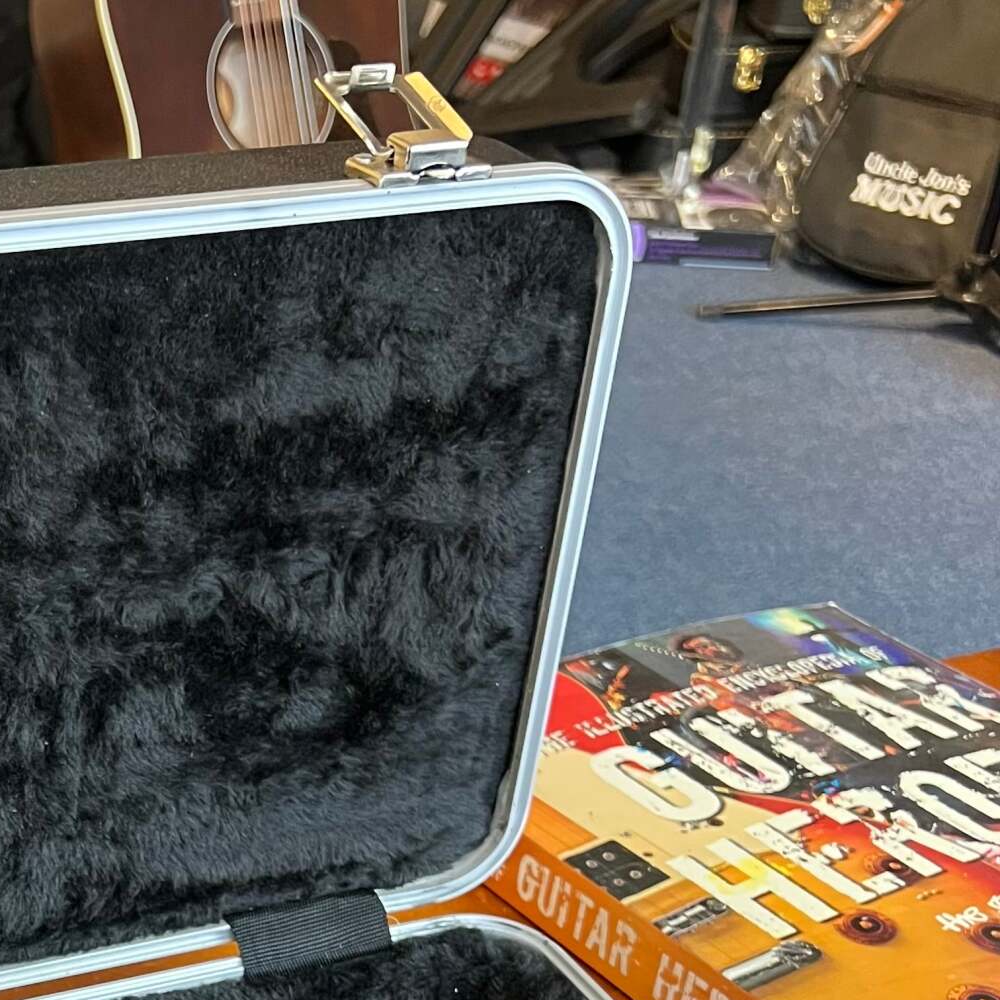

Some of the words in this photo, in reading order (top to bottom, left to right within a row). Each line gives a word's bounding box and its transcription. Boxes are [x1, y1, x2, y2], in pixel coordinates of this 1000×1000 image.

[849, 173, 961, 225] MUSIC
[573, 684, 718, 739] ILLUSTRATED
[716, 652, 862, 693] ENCYCLOPEDIA
[859, 645, 890, 661] OF
[589, 666, 1000, 823] GUITAR
[516, 853, 640, 977] GUITAR
[935, 905, 988, 933] the
